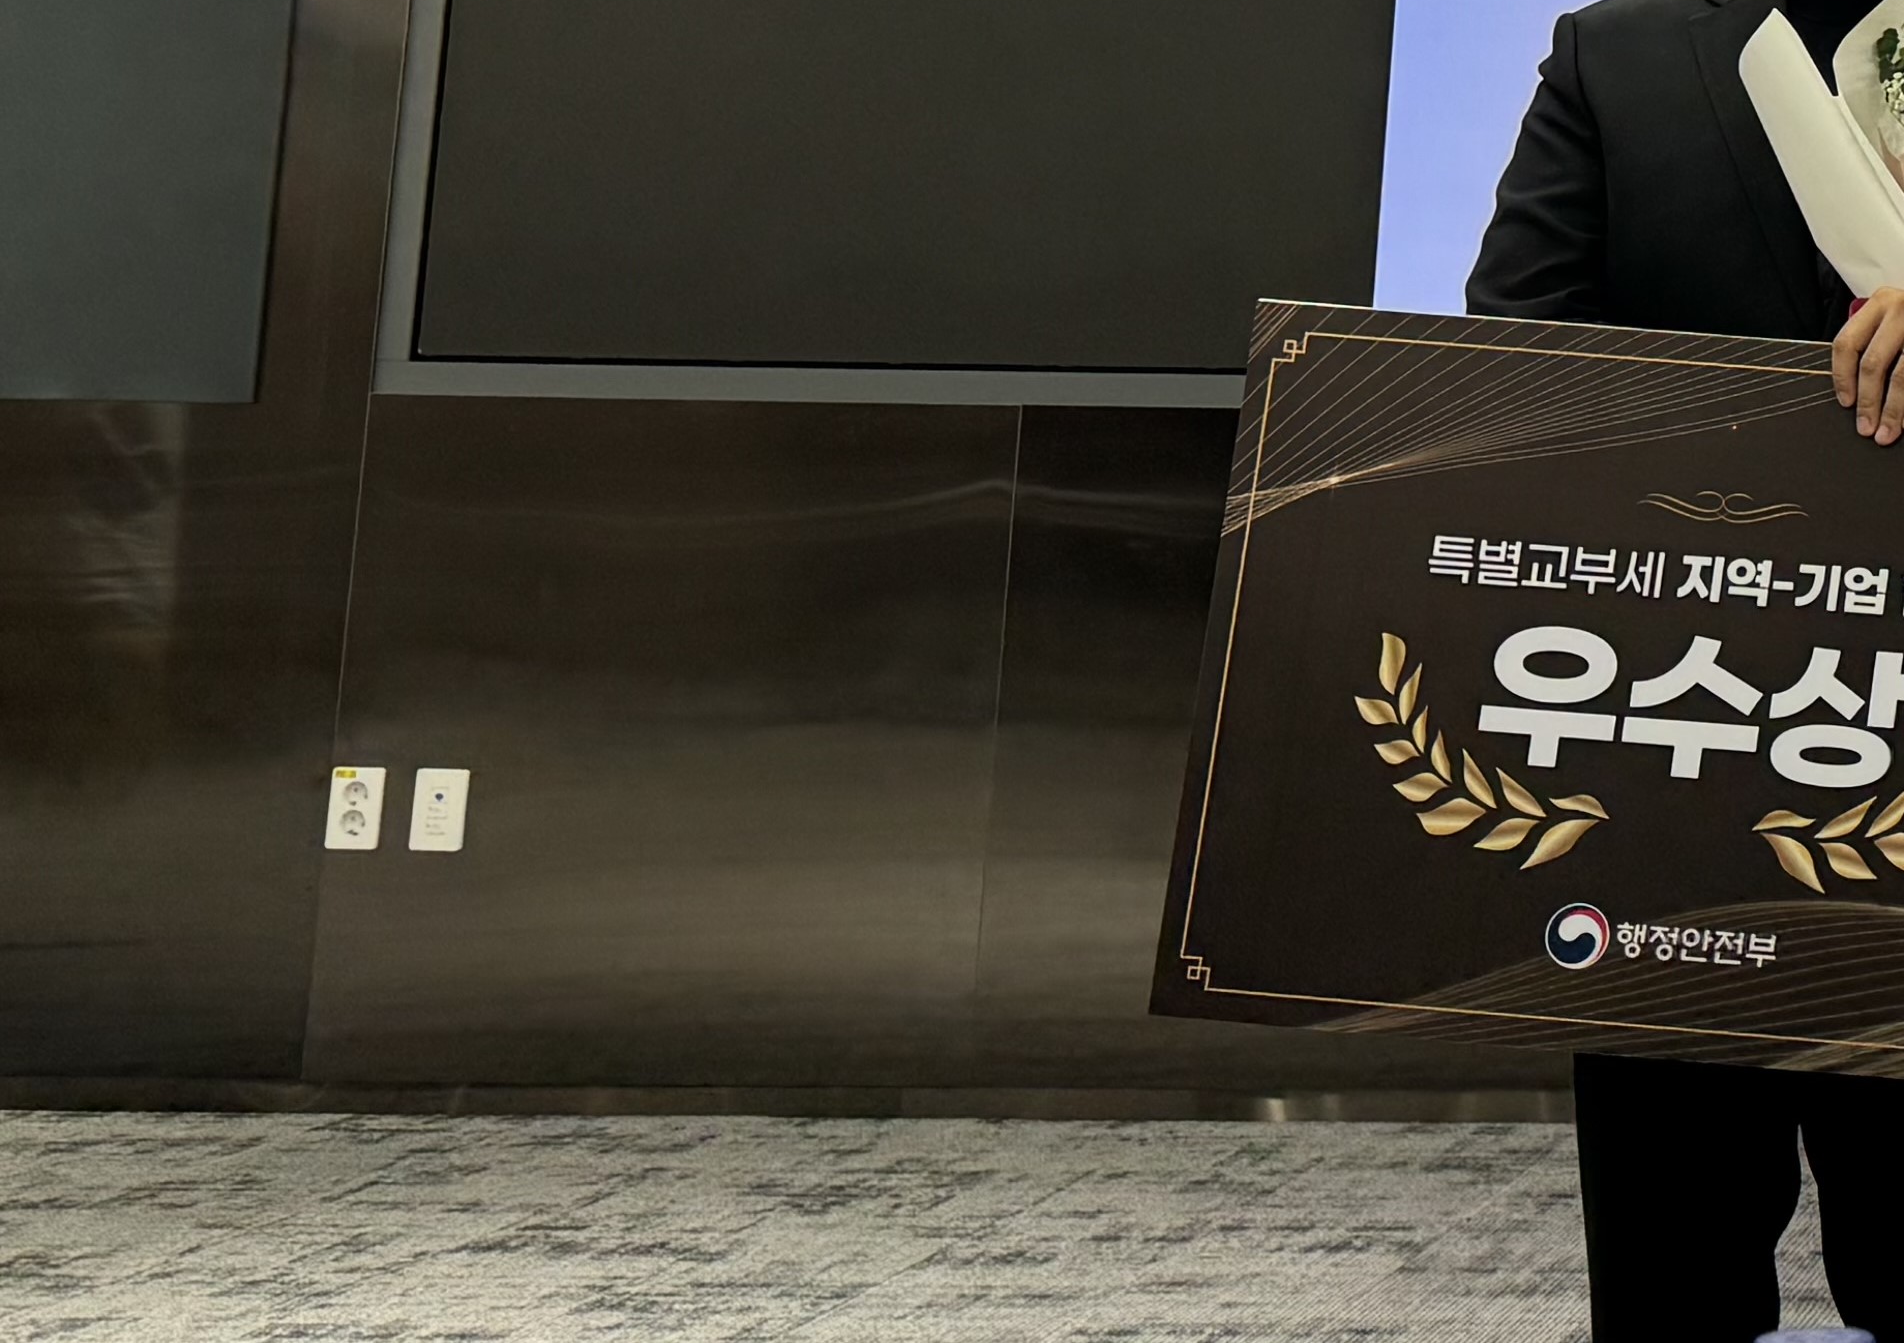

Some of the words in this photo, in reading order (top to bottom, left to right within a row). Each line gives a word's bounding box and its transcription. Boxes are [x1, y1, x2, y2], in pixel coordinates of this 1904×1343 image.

[1428, 535, 1666, 599] 특별교부세
[1676, 554, 1889, 615] 지역-기업
[1616, 921, 1777, 968] 행정안전부
